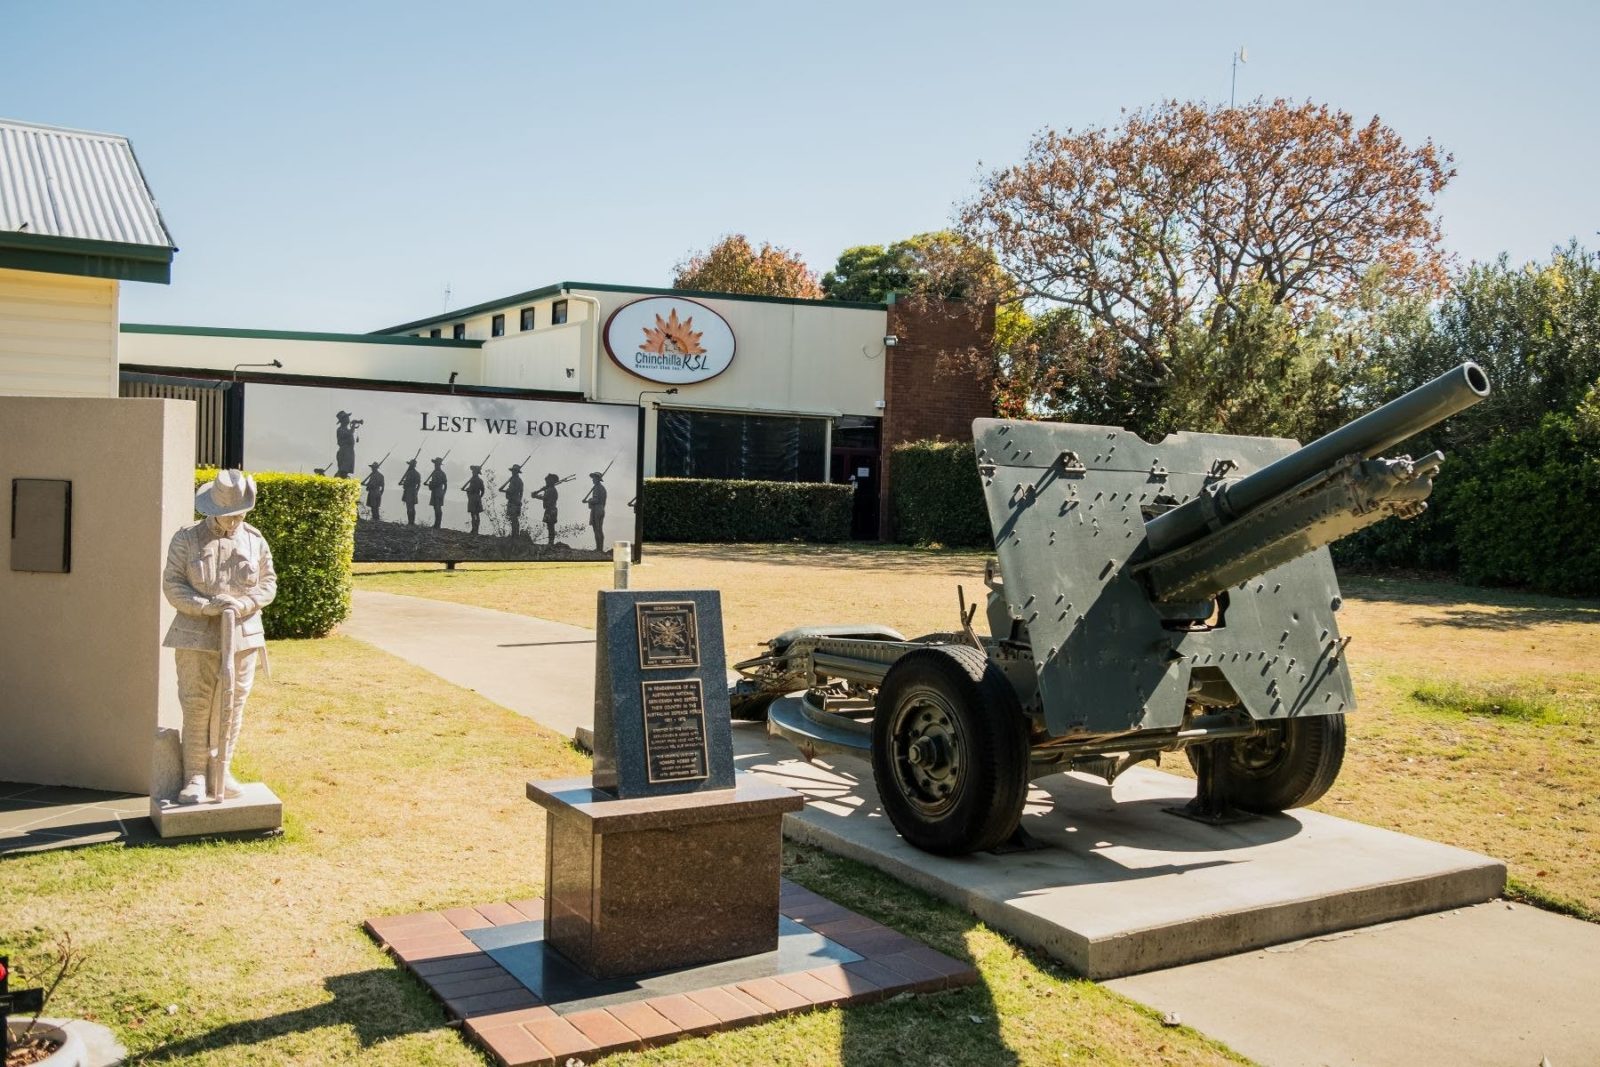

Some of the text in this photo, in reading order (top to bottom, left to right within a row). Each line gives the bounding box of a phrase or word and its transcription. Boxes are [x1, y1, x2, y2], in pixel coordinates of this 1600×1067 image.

[635, 352, 710, 371] Chinchilla RSL
[420, 412, 610, 440] LEST WE FORGET
